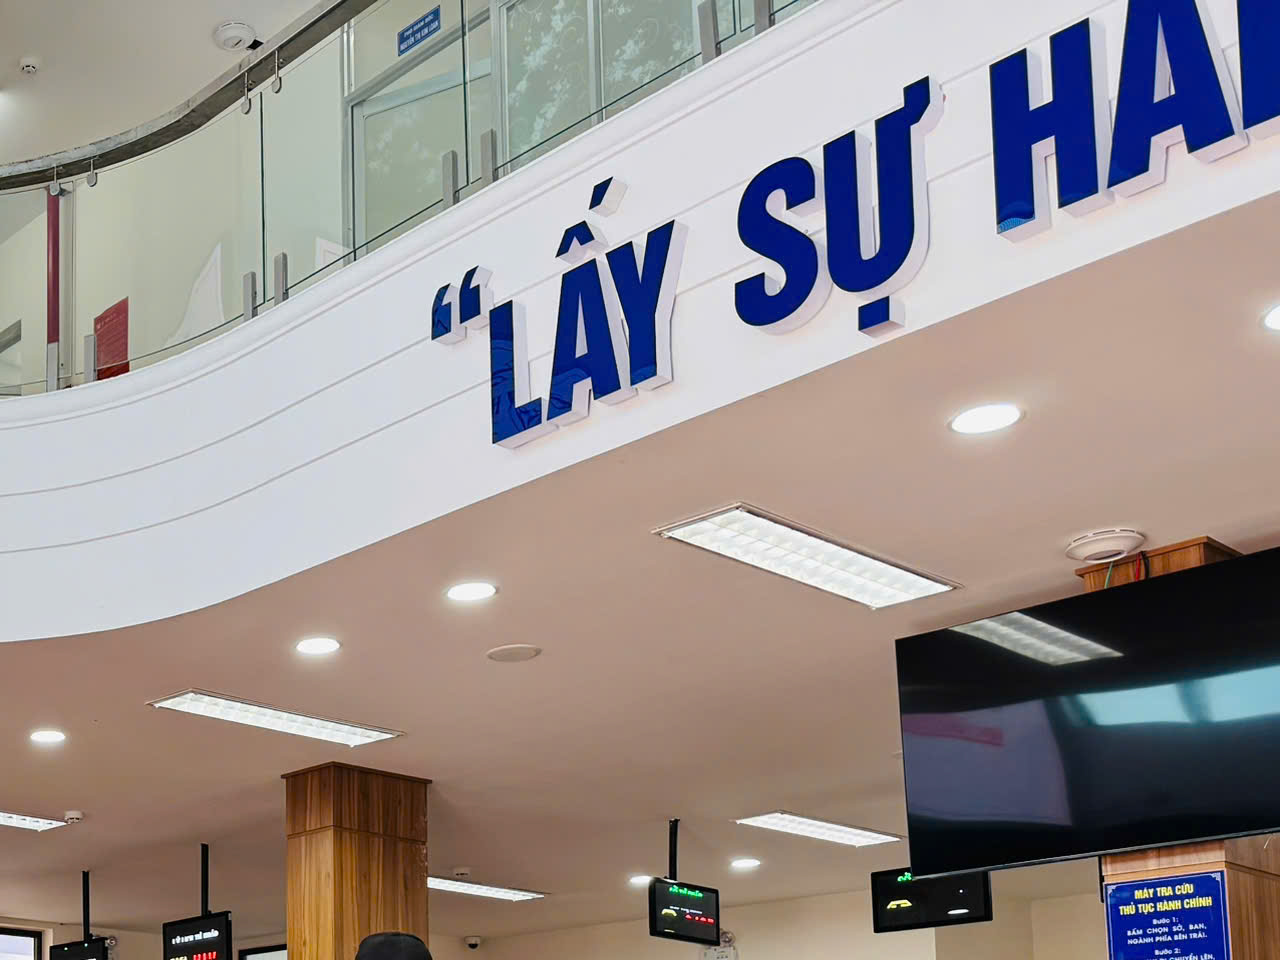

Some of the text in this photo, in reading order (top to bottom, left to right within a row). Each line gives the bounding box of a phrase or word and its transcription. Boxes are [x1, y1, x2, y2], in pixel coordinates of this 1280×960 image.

[734, 76, 932, 335] SỰ
[1135, 882, 1193, 899] MÁY TRA CỨU
[1119, 896, 1212, 915] THỦ TỤC HÀNH CHÍNH
[1128, 936, 1153, 944] NGÀNH
